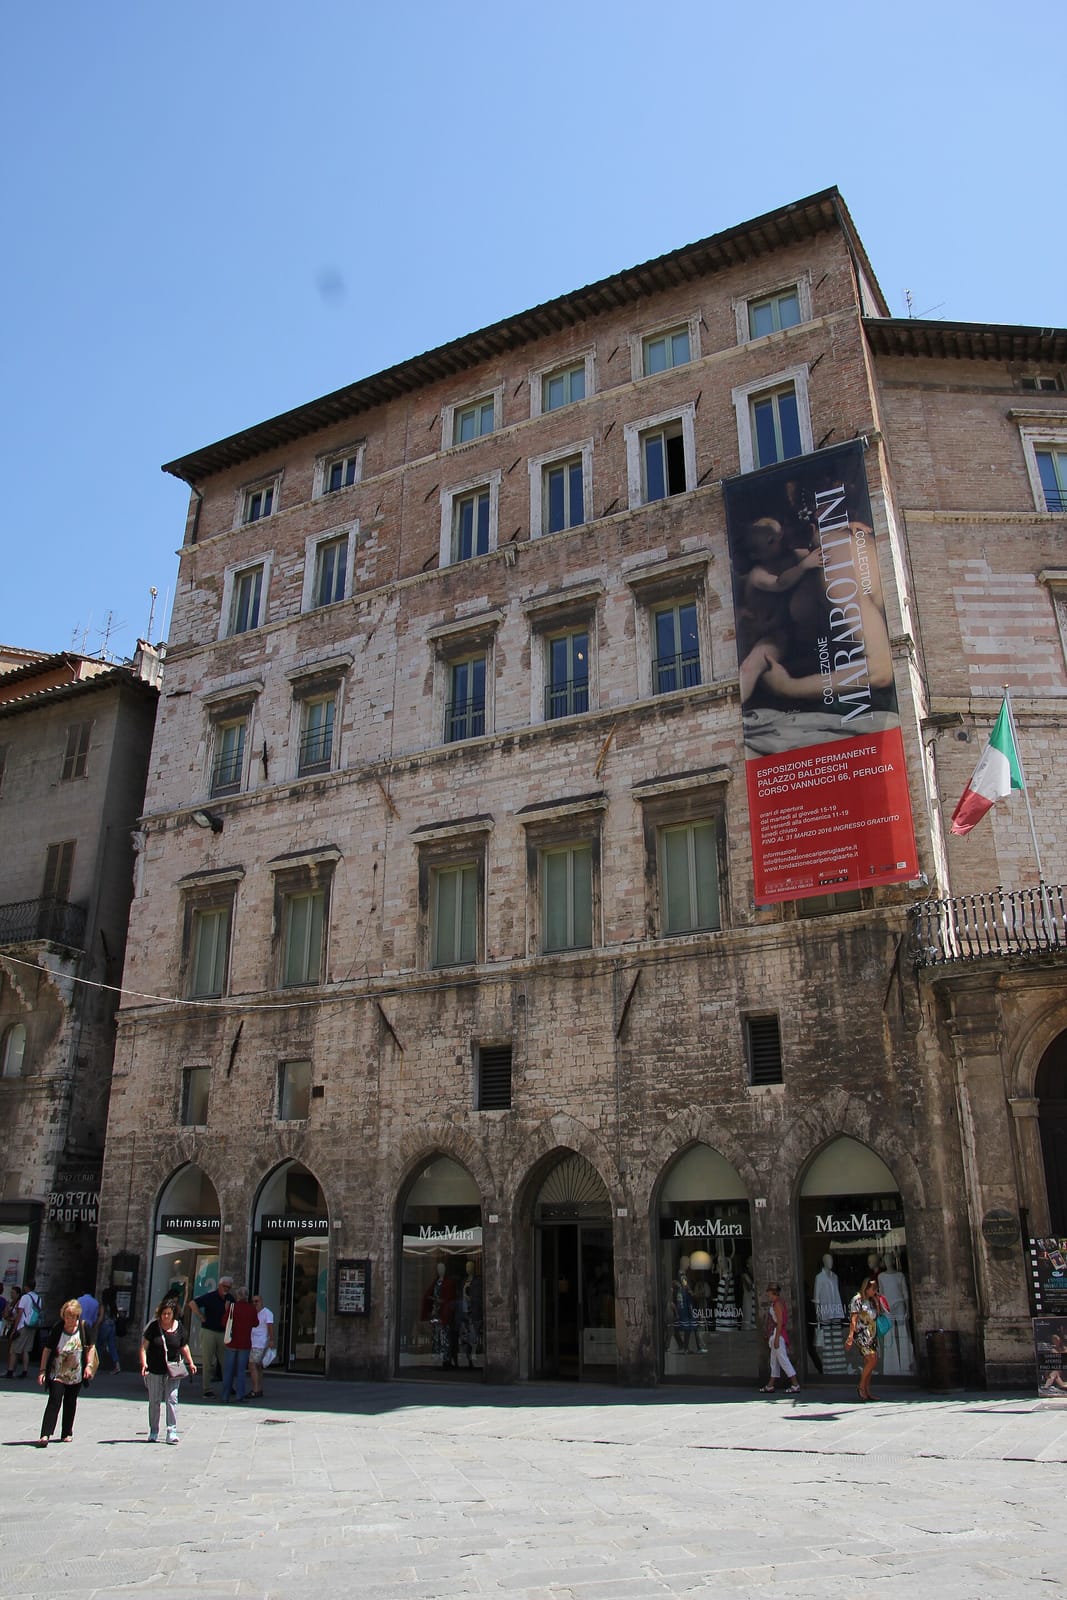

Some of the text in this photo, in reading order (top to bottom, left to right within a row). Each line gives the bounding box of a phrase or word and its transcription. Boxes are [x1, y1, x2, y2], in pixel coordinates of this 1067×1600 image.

[854, 530, 872, 596] COLLECTION
[814, 483, 874, 727] MARABOTTINI
[817, 635, 834, 705] COLLEZIONE
[757, 746, 877, 778] ESPOSIZIONE PERMANENTE
[758, 762, 848, 788] PALAZZO BALDESCHI
[758, 763, 894, 798] CORSO VANNUCCI 66, PERUGIA
[760, 811, 772, 819] orari
[780, 805, 804, 815] apertura
[803, 814, 832, 824] domenica
[832, 810, 849, 818] 11-19
[820, 805, 837, 814] 15-19
[762, 838, 776, 846] FINO
[794, 830, 817, 839] MARZO
[818, 827, 832, 835] 2016
[833, 820, 866, 832] INGRESSO
[866, 814, 900, 825] GRATUITO
[779, 827, 798, 835] chiuso
[418, 1224, 474, 1241] MaxMara
[674, 1218, 743, 1238] MaxMara
[815, 1214, 891, 1233] MaxMara
[692, 1308, 713, 1318] SALDI
